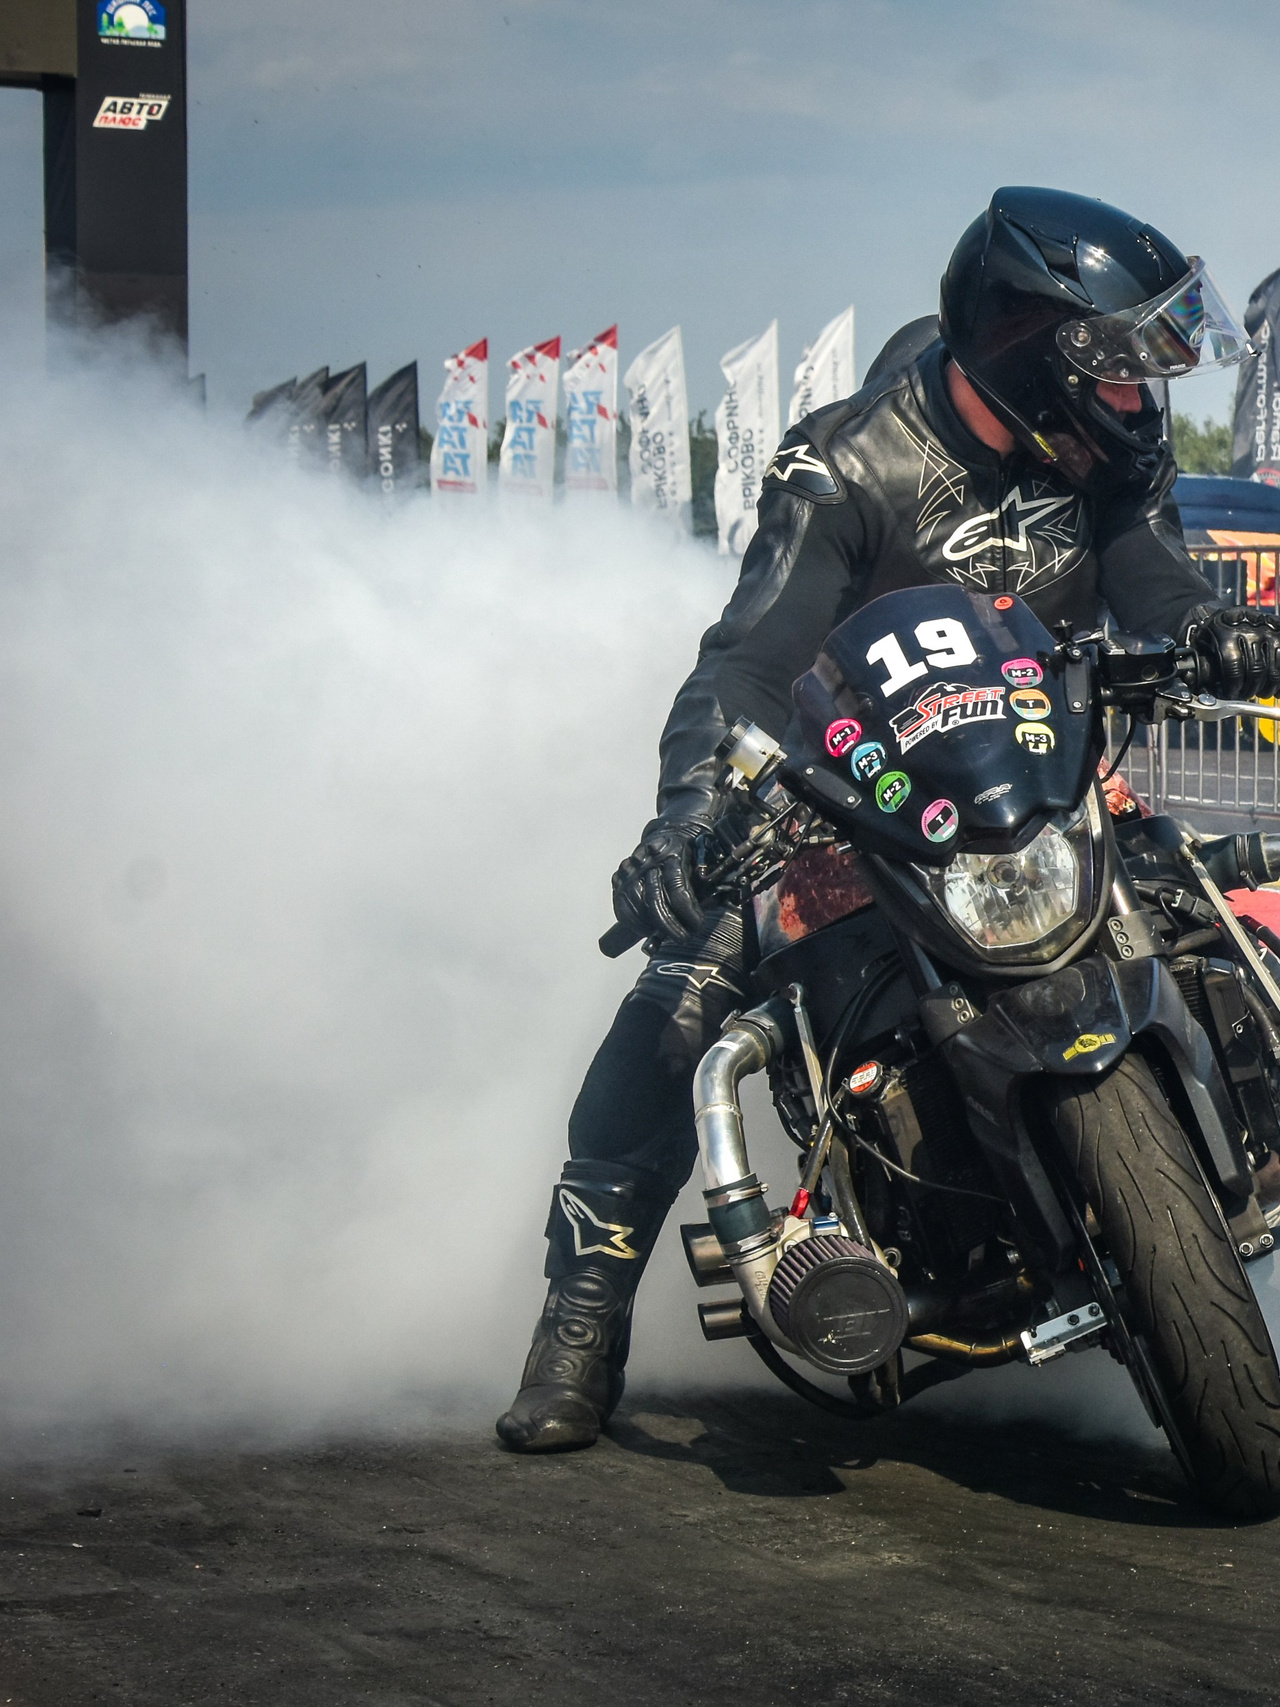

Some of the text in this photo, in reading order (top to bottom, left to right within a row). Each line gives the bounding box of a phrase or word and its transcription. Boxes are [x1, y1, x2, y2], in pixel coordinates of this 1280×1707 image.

[103, 100, 163, 116] АВТО
[98, 115, 142, 127] ПЛЮС
[865, 616, 979, 699] 19
[1011, 668, 1034, 678] M-2
[912, 689, 1003, 723] STREET
[1026, 700, 1034, 708] T
[832, 727, 851, 746] M-1
[904, 719, 939, 748] POWERED BY
[1024, 733, 1047, 743] M-3
[858, 751, 879, 770] M-3
[882, 781, 902, 802] M-2
[935, 815, 944, 824] T
